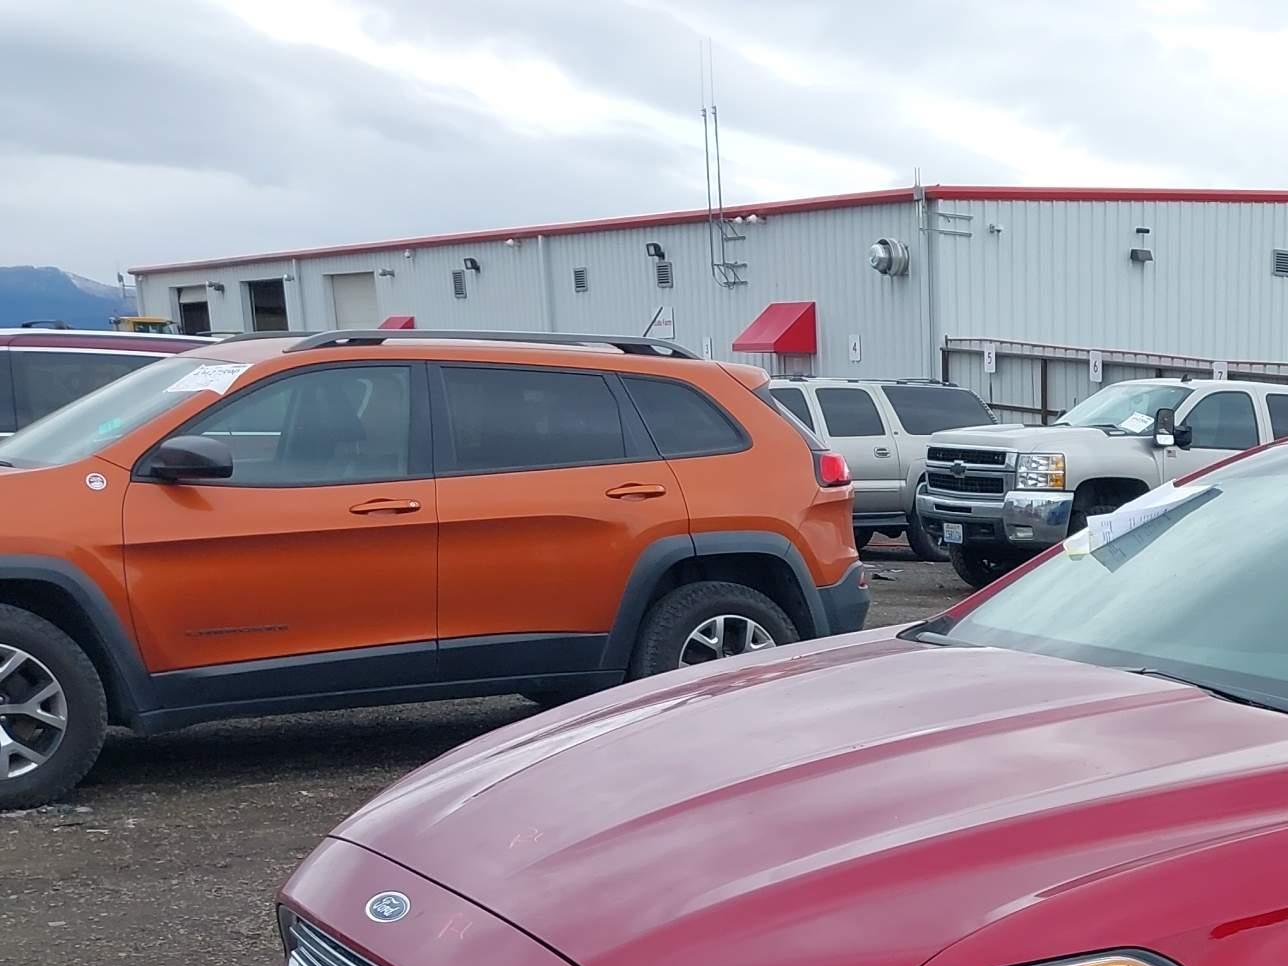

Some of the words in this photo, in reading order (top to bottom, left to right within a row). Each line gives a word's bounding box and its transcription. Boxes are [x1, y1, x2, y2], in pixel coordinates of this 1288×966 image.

[852, 340, 858, 354] 4
[986, 352, 993, 365] 5
[1092, 361, 1099, 373] 6
[373, 897, 400, 917] Ford
